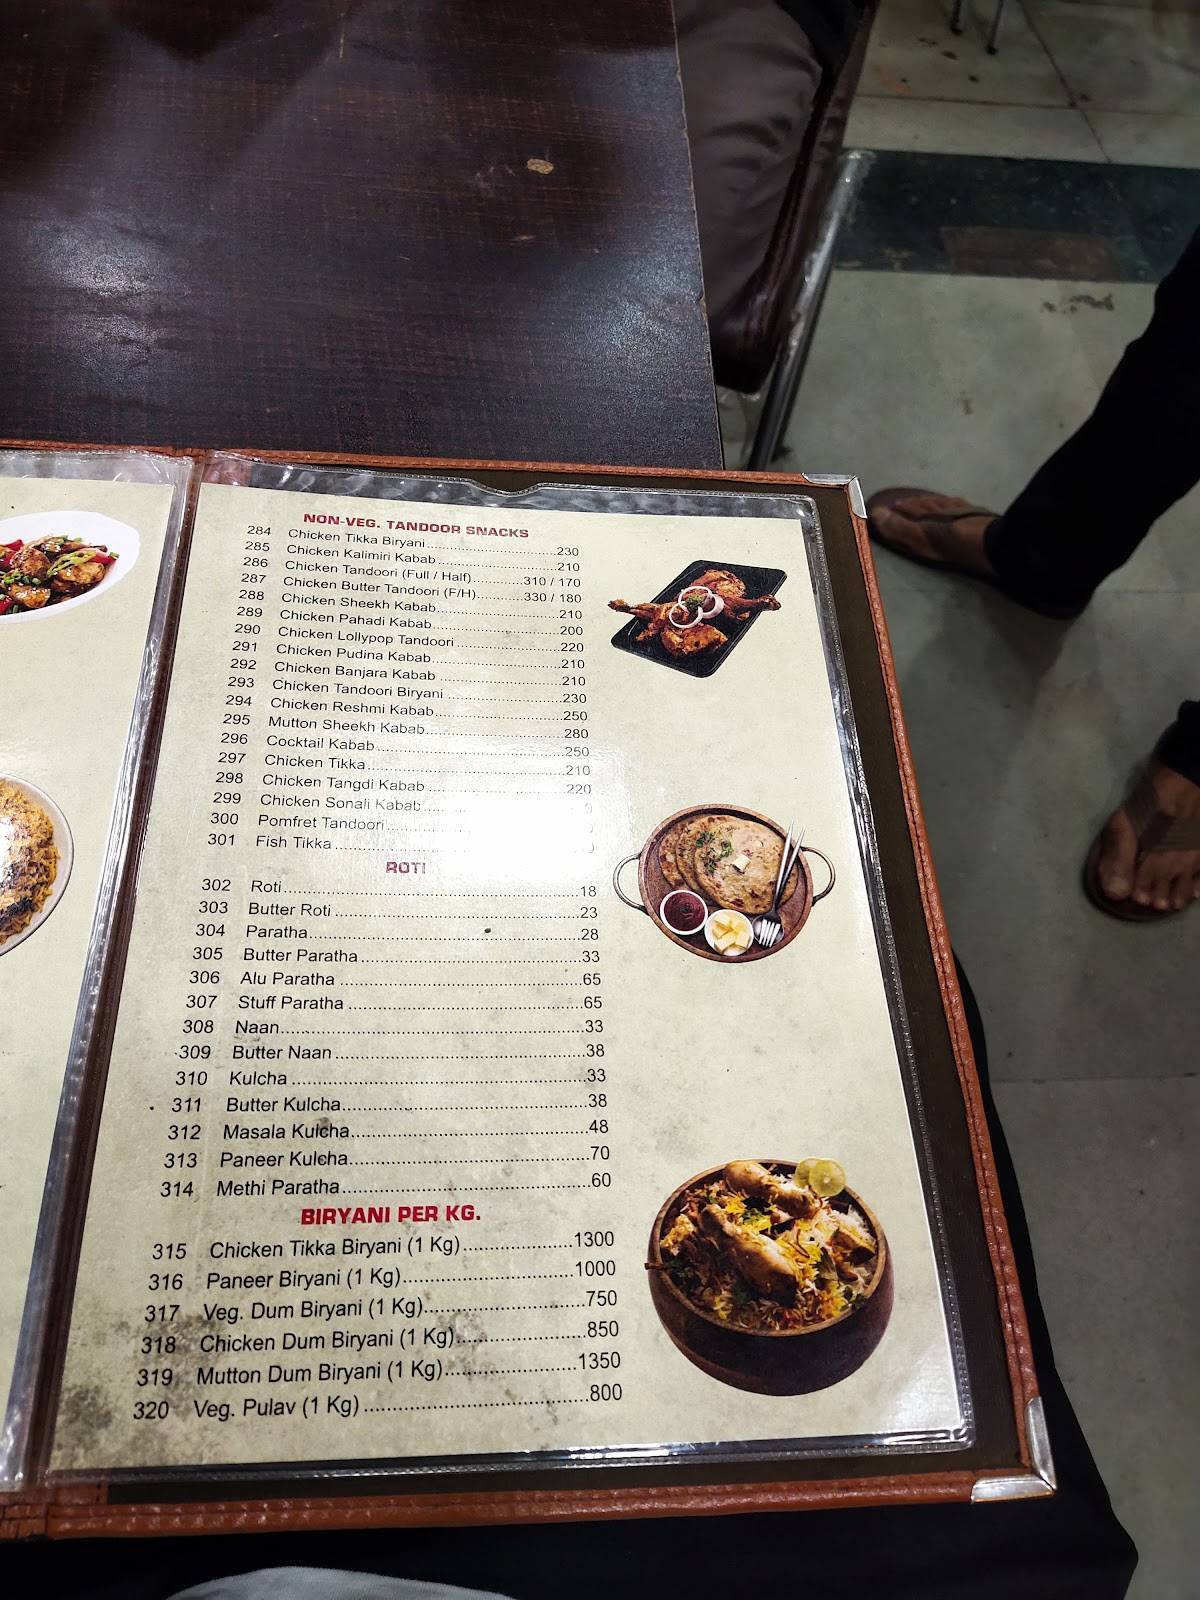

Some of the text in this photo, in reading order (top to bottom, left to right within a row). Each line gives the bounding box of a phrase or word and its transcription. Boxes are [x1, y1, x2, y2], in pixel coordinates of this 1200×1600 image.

[304, 514, 528, 538] NON-VEG. TANDOOR SNACKS
[247, 526, 579, 556] 284 Chicken Tikka Biryani 230
[245, 541, 580, 571] 285 Chicken Kalimiri Kabab 210
[238, 590, 582, 619] 288 Chicken Sheekh Kabab 210
[237, 606, 583, 635] 289 Chicken Pahadi Kabab 200
[234, 624, 584, 652] 290 Chicken Lollypop Tandoori 220
[232, 641, 584, 669] 291 Chicken Pudina Kabab 210
[230, 658, 586, 686] 292 Chicken Banjara Kabab 210
[228, 676, 586, 703] 293 Chicken Tandoori Biryani 230
[226, 695, 587, 721] 294 Chicken Reshmi Kabab 250
[223, 714, 588, 738] 295 Mutton Sheekh Kabab 280
[221, 732, 589, 756] 296 Cocktail Kabab 250
[386, 862, 427, 874] ROTI
[202, 878, 596, 897] 302 Roti 18
[198, 901, 597, 918] 303 Butter Roti 23
[196, 924, 598, 940] 304 Paratha 28
[193, 947, 600, 962] 305 Butter Paratha 33
[190, 970, 601, 986] 306 Alu Paratha 65
[186, 995, 602, 1010] 307 Stuff Paratha 65
[182, 1020, 603, 1034] 308 Naan 33
[179, 1044, 604, 1059] 309 Butter Naan 38
[176, 1068, 606, 1086] 310 Kulcha 33
[172, 1094, 607, 1112] 311 Butter Kulcha 38
[168, 1120, 608, 1141] 312 Masala Kulcha 48
[164, 1146, 610, 1168] 313 Paneer Kulcha 70
[160, 1172, 611, 1197] 314 Methi Paratha 60
[301, 1205, 481, 1225] BIRYANI PER KG.
[152, 1231, 614, 1260] 315 Chicken Tikka Biryani (1 Kg) 1300
[148, 1260, 616, 1291] 316 Paneer Biryani (1 Kg) 1000
[145, 1290, 617, 1324] 317 Veg. Dum Biryani (1 Kg) 750
[141, 1320, 618, 1354] 318 Chicken Dum Biryani (1 Kg) 850
[137, 1352, 620, 1386] 319 Mutton Dum Biryani (1 Kg) 1350
[133, 1384, 622, 1422] 320 Veg. Pulav (1 Kg) 800
